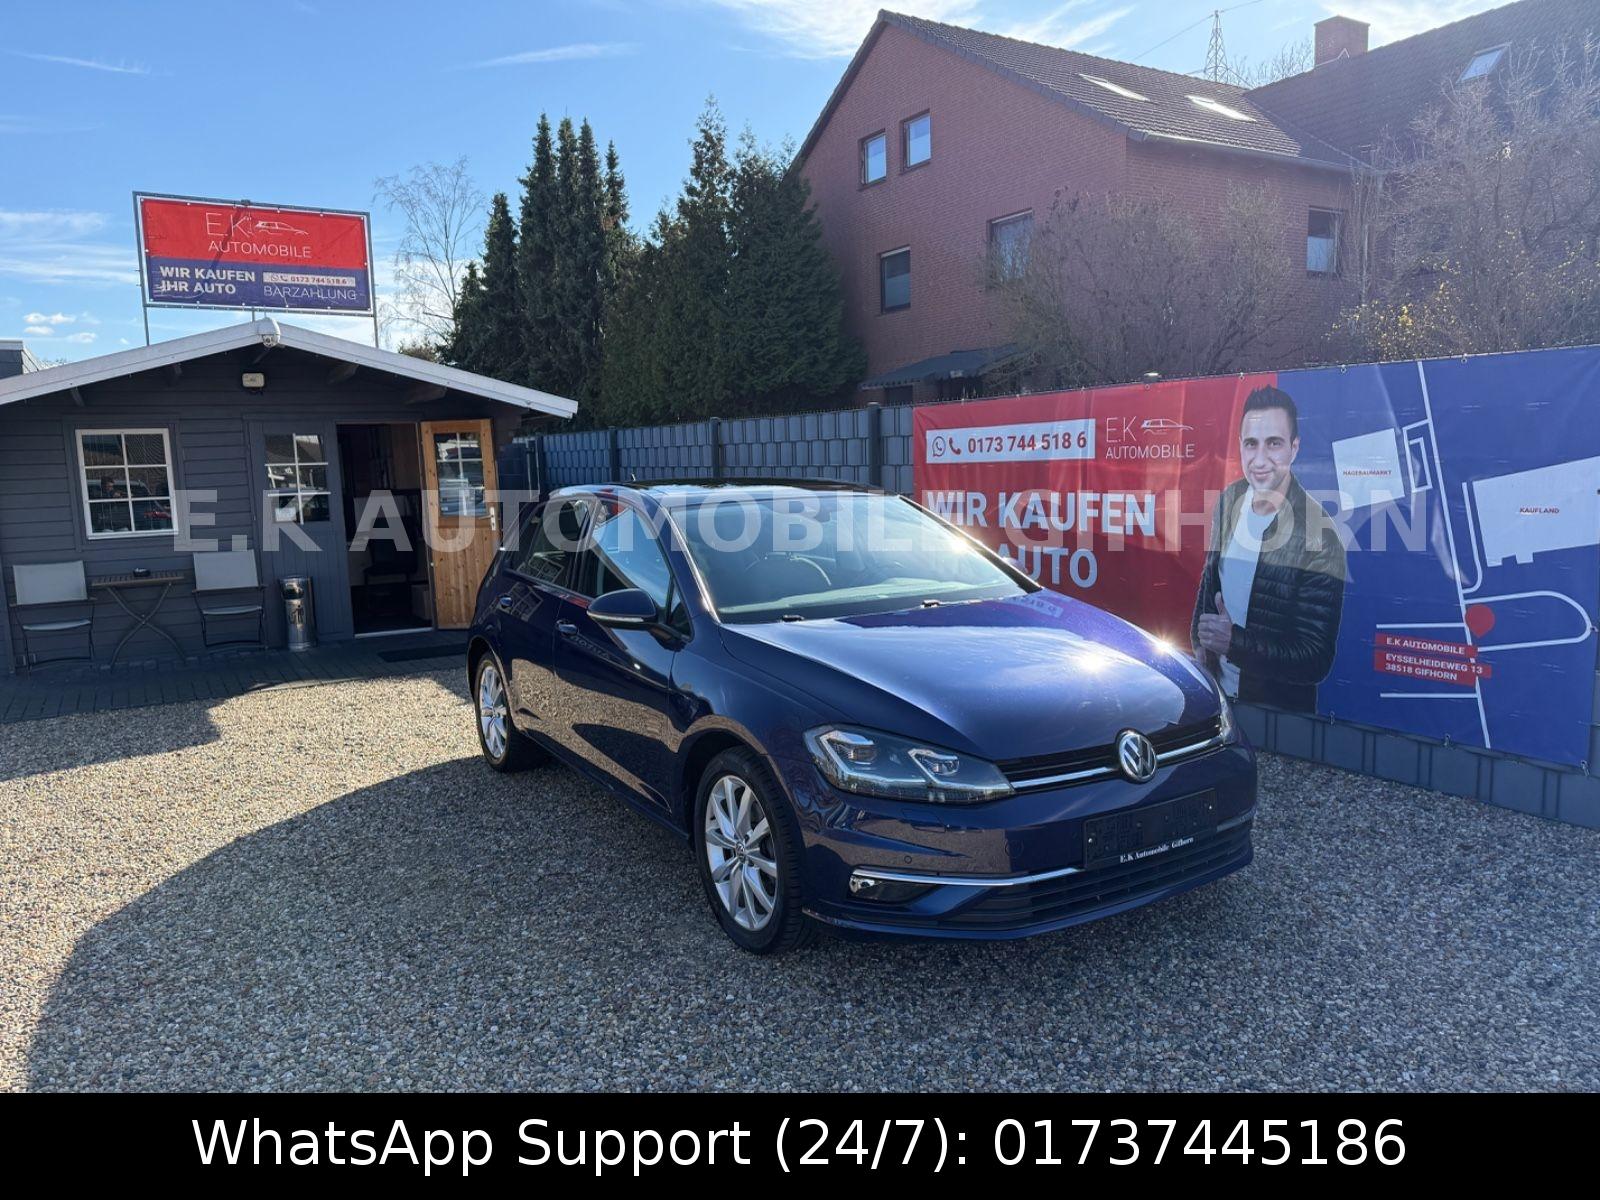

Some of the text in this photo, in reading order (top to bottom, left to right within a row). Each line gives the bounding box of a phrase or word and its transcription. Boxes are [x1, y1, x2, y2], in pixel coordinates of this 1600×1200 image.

[208, 241, 312, 259] AUTOMOBILE
[160, 266, 256, 282] WIR KAUFEN
[160, 280, 236, 295] IHR AUTO
[263, 285, 356, 300] BARZAHLUNG
[968, 431, 1087, 454] 0173 744 518 6
[1105, 444, 1195, 460] AUTOMOBILE
[927, 491, 1156, 537] WIR KAUFEN
[1386, 637, 1465, 655] E.K AUTOMOBILE
[1385, 663, 1457, 681] 38518 GIFHORN
[1386, 653, 1483, 674] EYSSELHEIDEWEG 13
